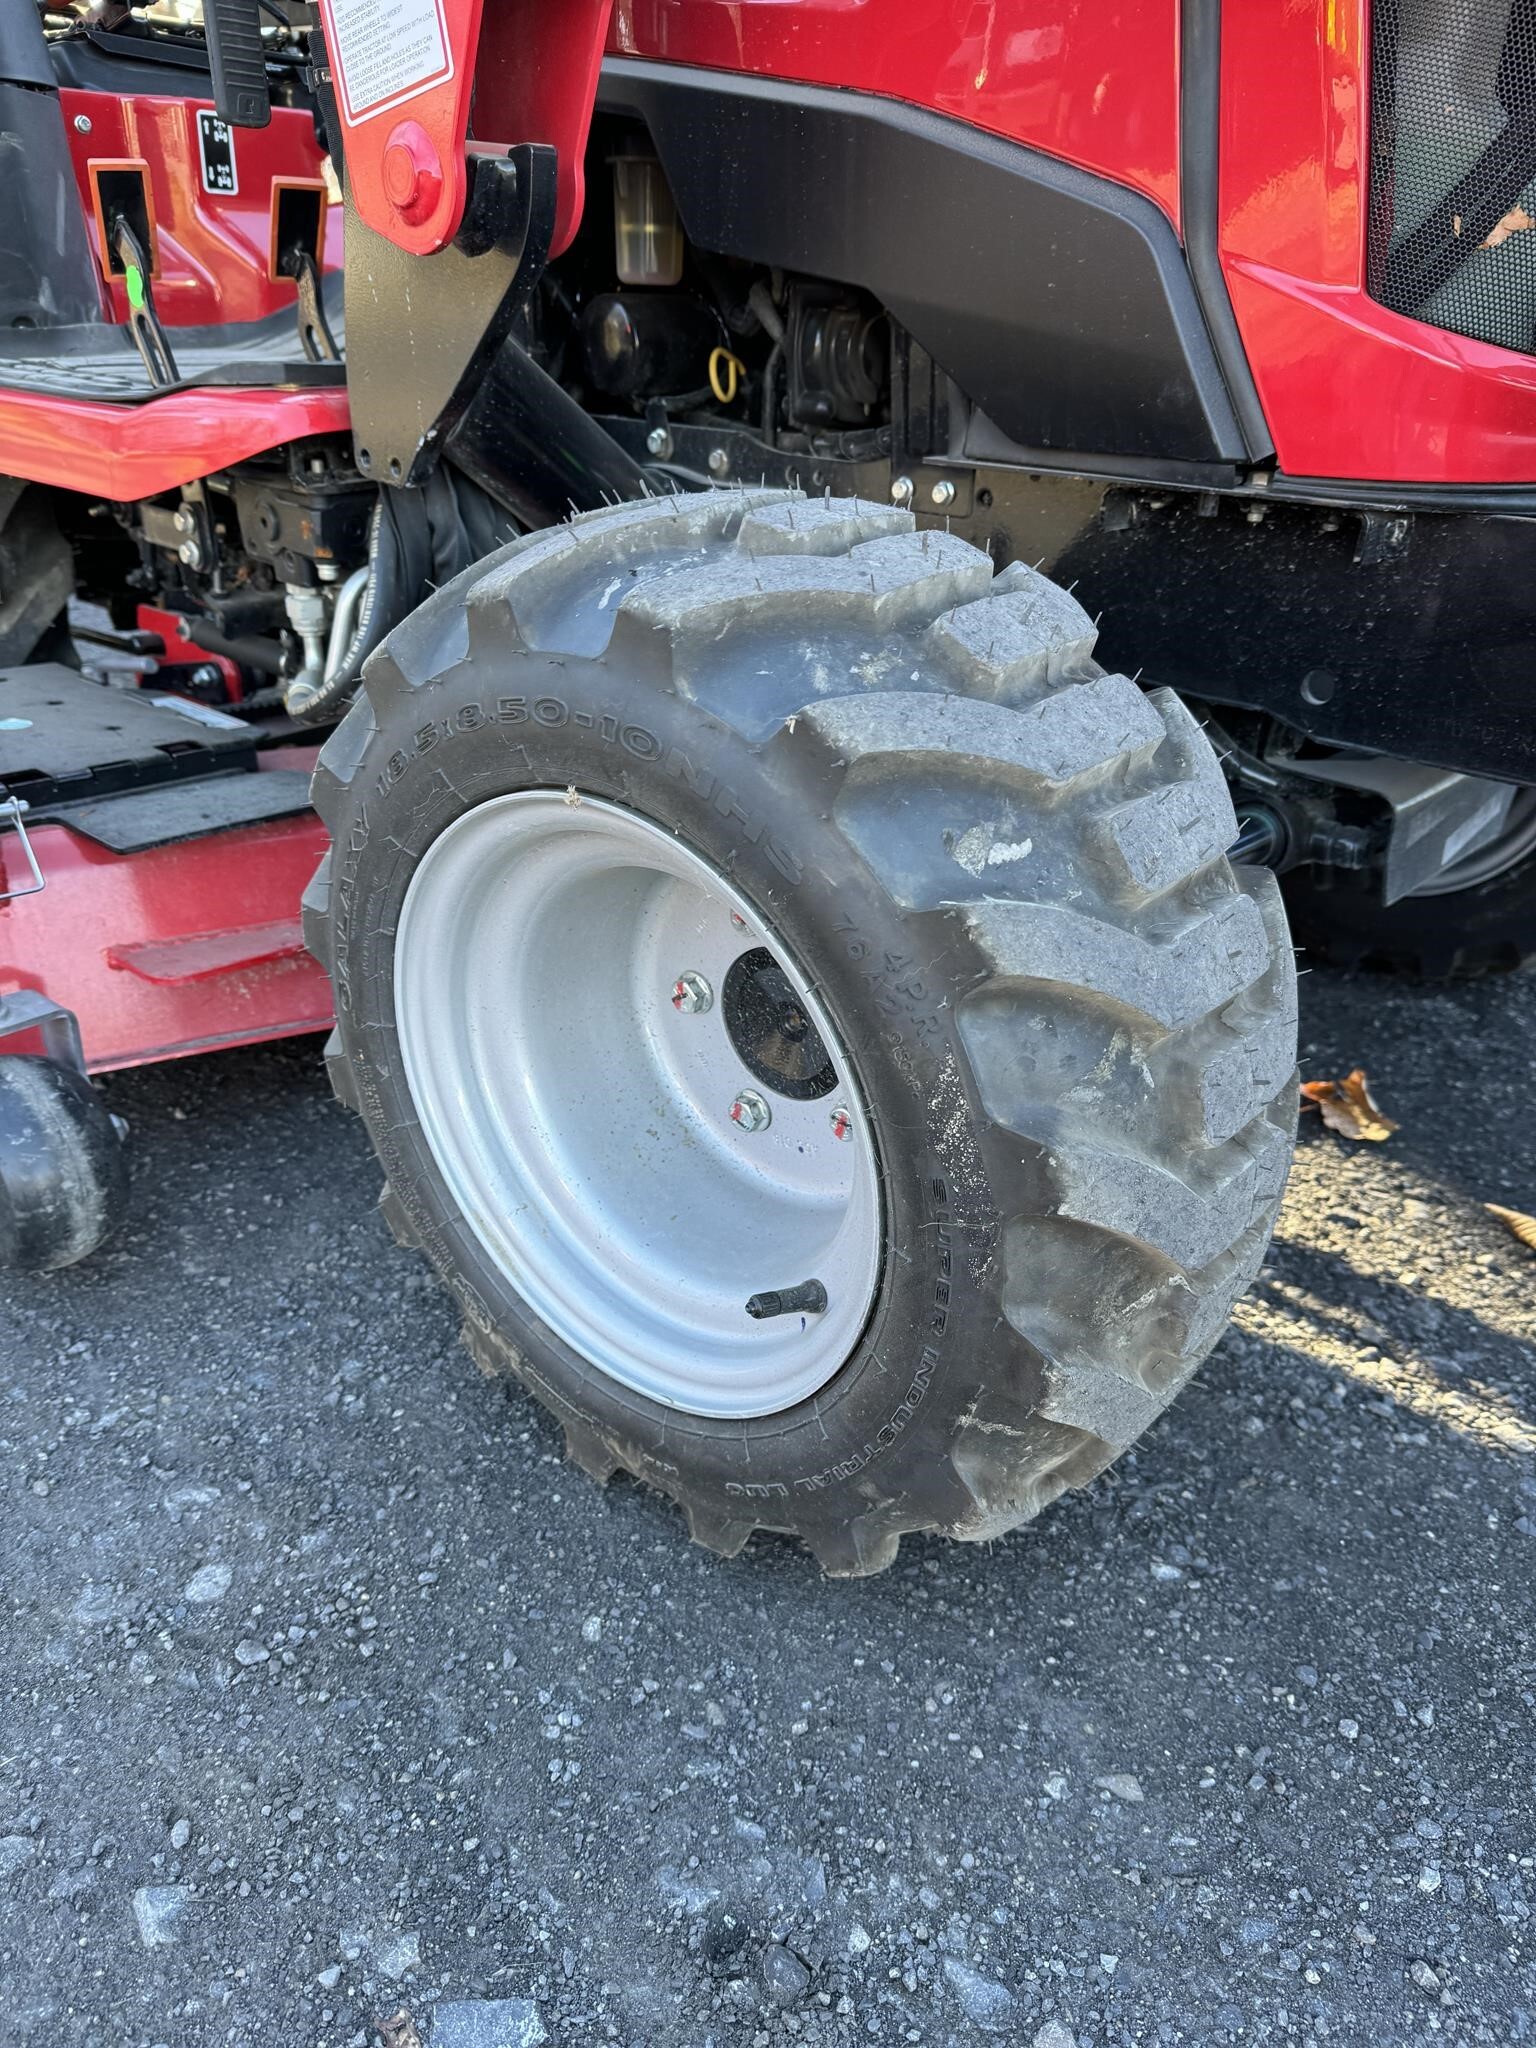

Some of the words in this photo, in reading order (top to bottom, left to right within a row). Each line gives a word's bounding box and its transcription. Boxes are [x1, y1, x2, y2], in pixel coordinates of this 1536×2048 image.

[358, 57, 364, 65] TO
[380, 14, 386, 22] TO
[396, 22, 411, 35] SPEED
[421, 9, 435, 22] LOAD
[664, 746, 805, 886] NHS
[336, 801, 370, 1012] GALAXY
[932, 1178, 954, 1338] SUPER
[793, 1347, 941, 1492] INDUSTRIAL
